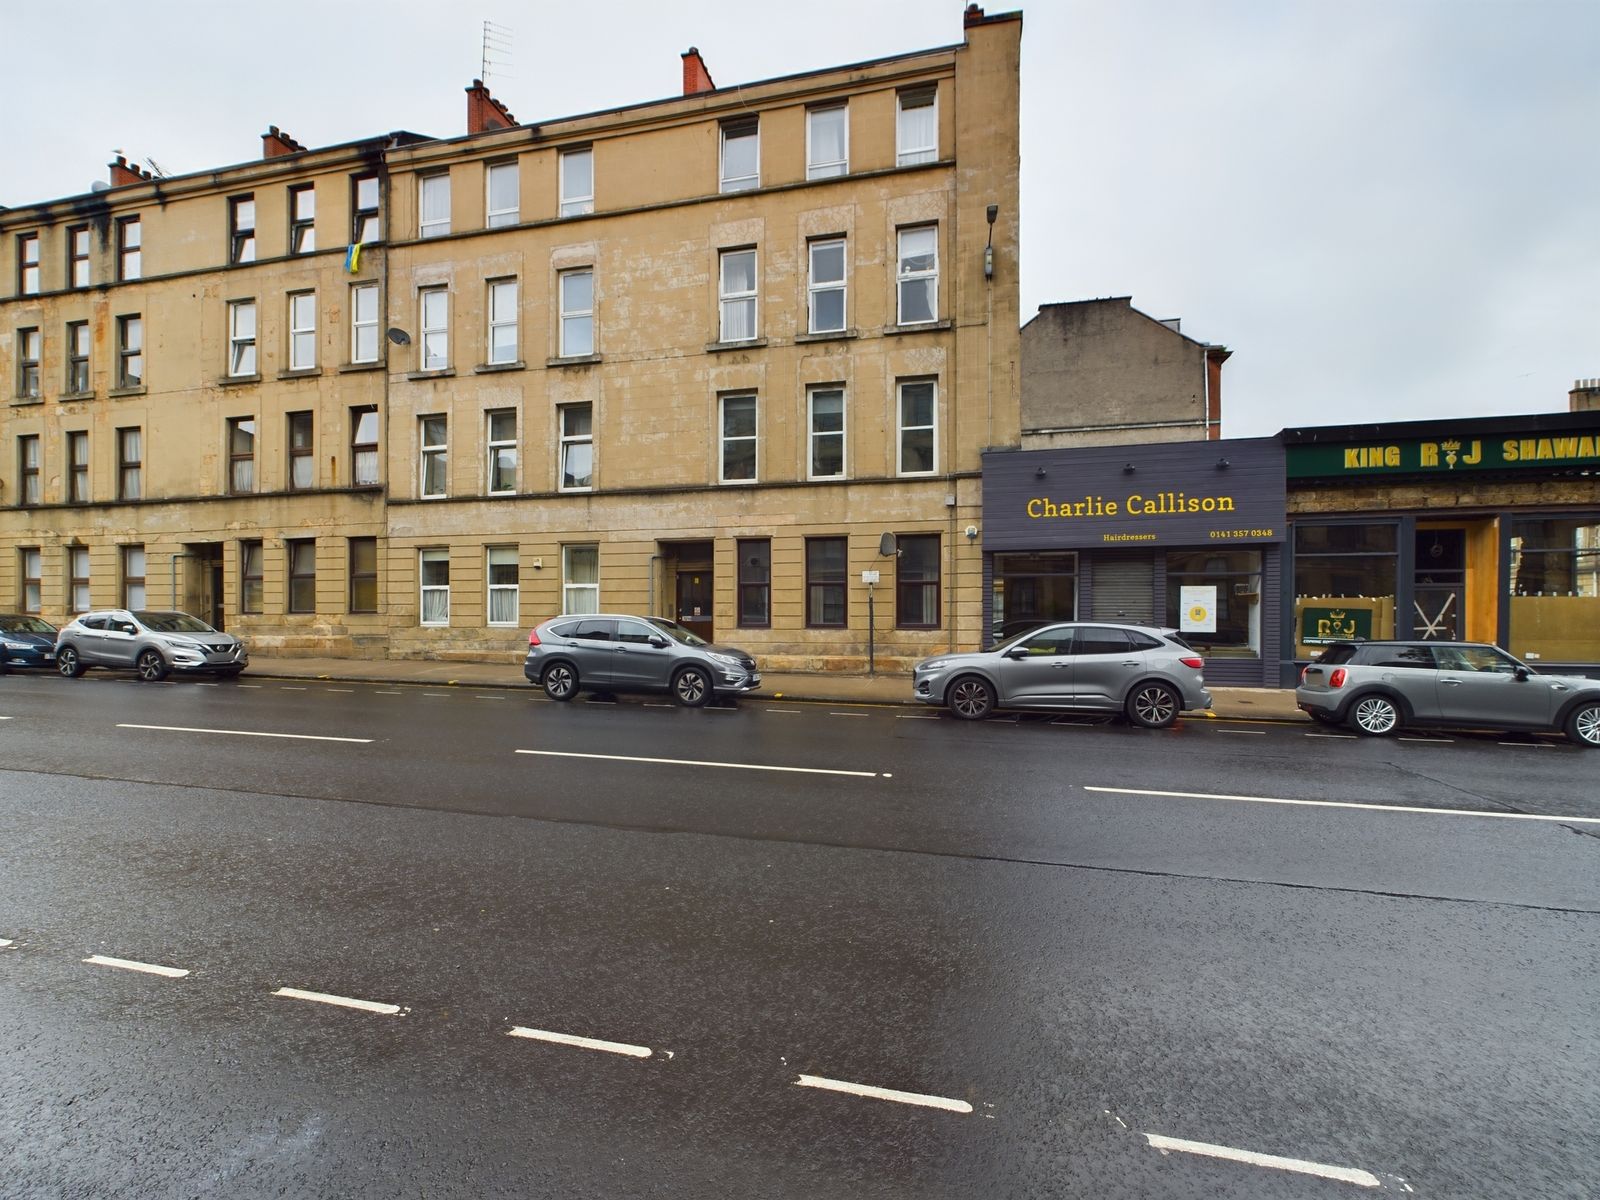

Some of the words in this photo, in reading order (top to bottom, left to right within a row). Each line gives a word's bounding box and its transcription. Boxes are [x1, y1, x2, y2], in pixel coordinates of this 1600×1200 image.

[1344, 446, 1400, 469] KING
[1420, 442, 1439, 467] R
[1027, 496, 1118, 518] Charlie
[1126, 492, 1235, 516] Callison
[1103, 533, 1156, 542] Hairdressers
[1210, 530, 1231, 539] 0141
[1233, 529, 1249, 538] 357
[1251, 529, 1273, 538] 0348
